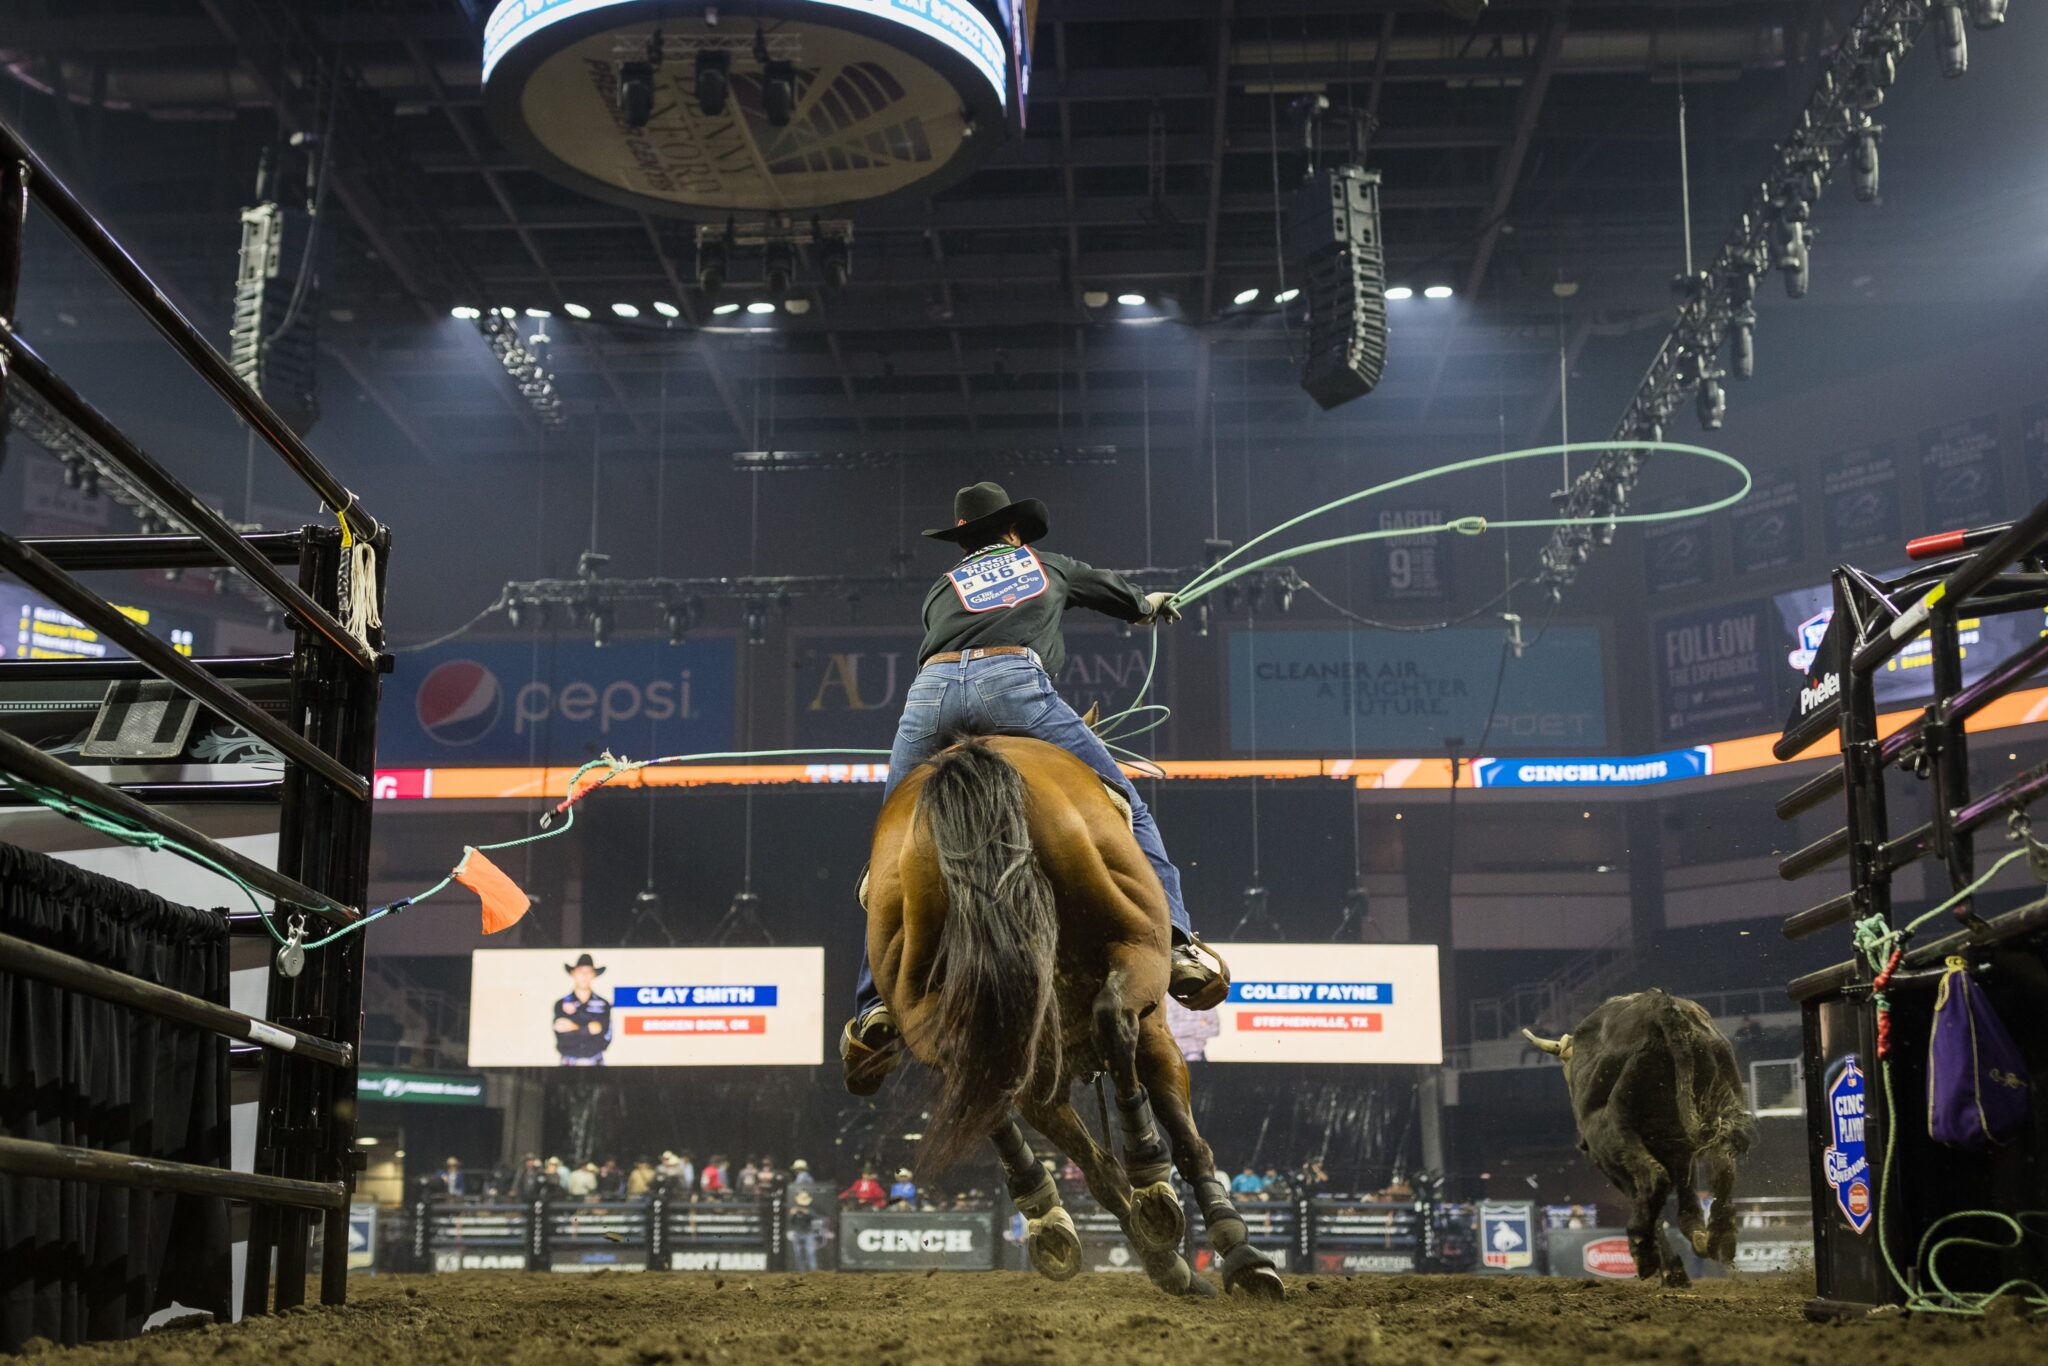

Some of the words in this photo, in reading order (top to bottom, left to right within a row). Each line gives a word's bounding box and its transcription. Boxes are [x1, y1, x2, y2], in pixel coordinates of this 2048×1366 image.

[1389, 548, 1412, 589] 9
[1666, 614, 1756, 669] FOLLOW
[1257, 661, 1372, 682] CLEANER
[1316, 681, 1335, 699] A
[1342, 679, 1470, 699] BRIGHTER
[514, 669, 692, 734] pepsi
[1488, 714, 1594, 736] POET
[1518, 764, 1599, 782] CINCH
[1600, 760, 1667, 781] PLAYOFFS
[637, 988, 689, 1004] CLAY
[692, 987, 755, 1003] SMITH
[1240, 984, 1313, 1000] COLEBY
[1316, 985, 1378, 1000] PAYNE
[1252, 1016, 1348, 1029] STEPHENVILLE,
[1350, 1017, 1368, 1028] TX
[1835, 1094, 1864, 1117] CINC
[1838, 1117, 1865, 1143] PLAYO
[857, 1229, 973, 1252] CINCH
[463, 1255, 525, 1269] RAM
